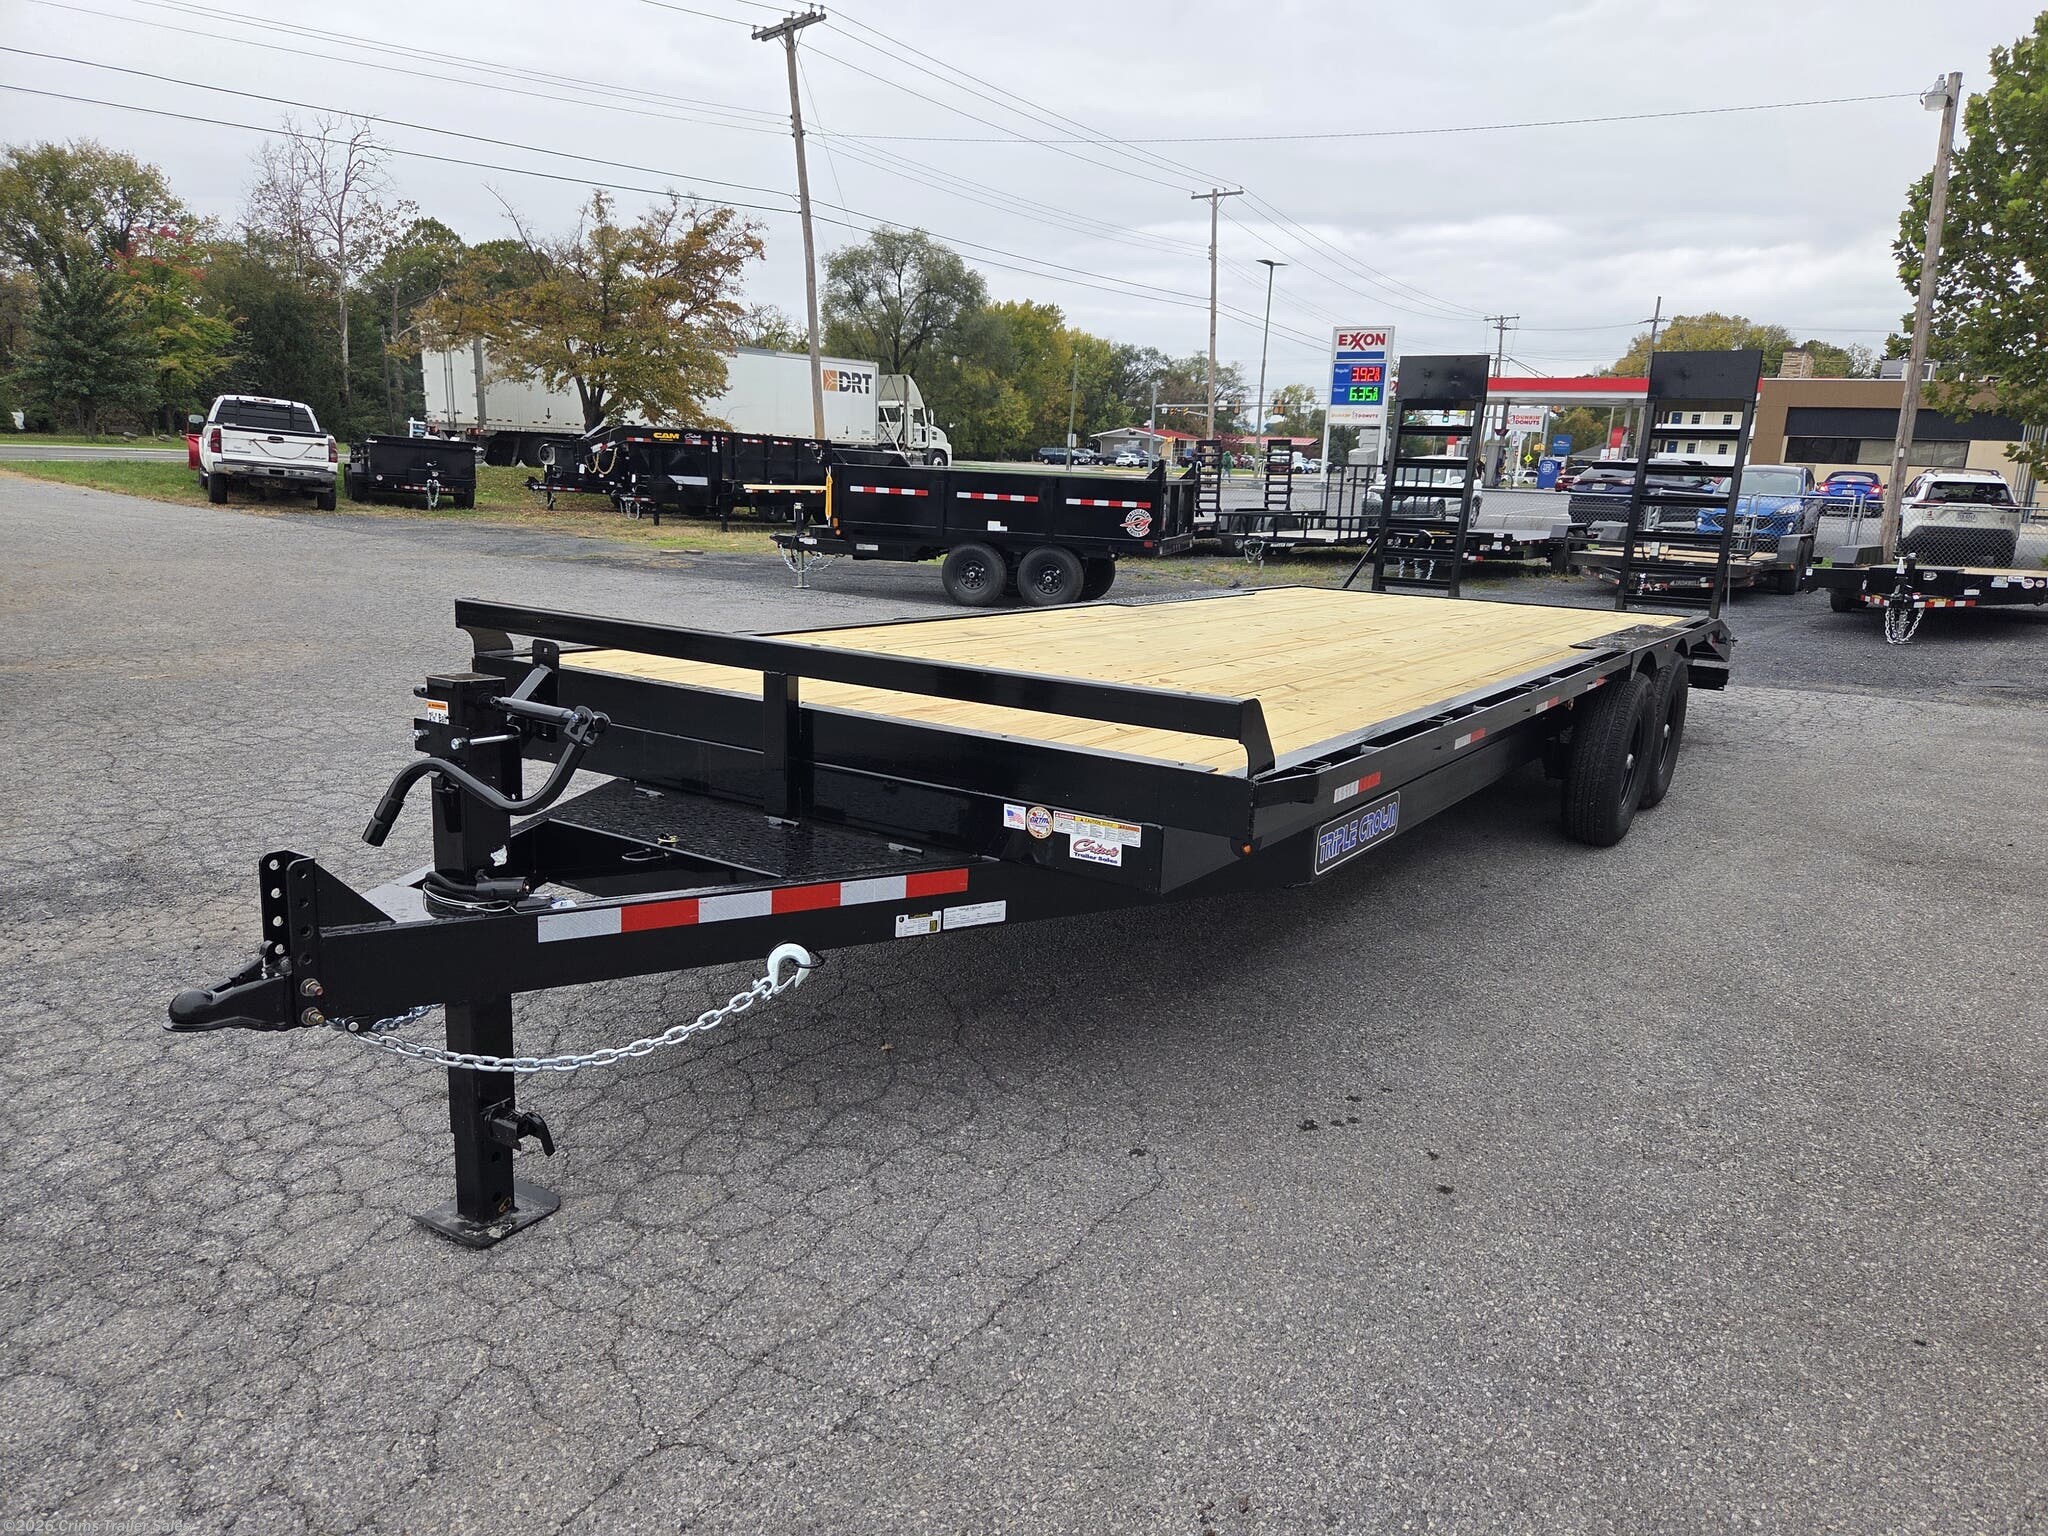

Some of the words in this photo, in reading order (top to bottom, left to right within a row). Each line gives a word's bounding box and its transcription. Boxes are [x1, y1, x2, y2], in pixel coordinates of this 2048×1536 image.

[1338, 332, 1387, 351] EXXON
[839, 371, 872, 394] DRT
[653, 432, 680, 440] CAM
[1320, 820, 1359, 864] TRIPLE
[1359, 802, 1398, 843] CROWN
[1074, 852, 1097, 860] Trailer
[1097, 856, 1118, 864] Sales
